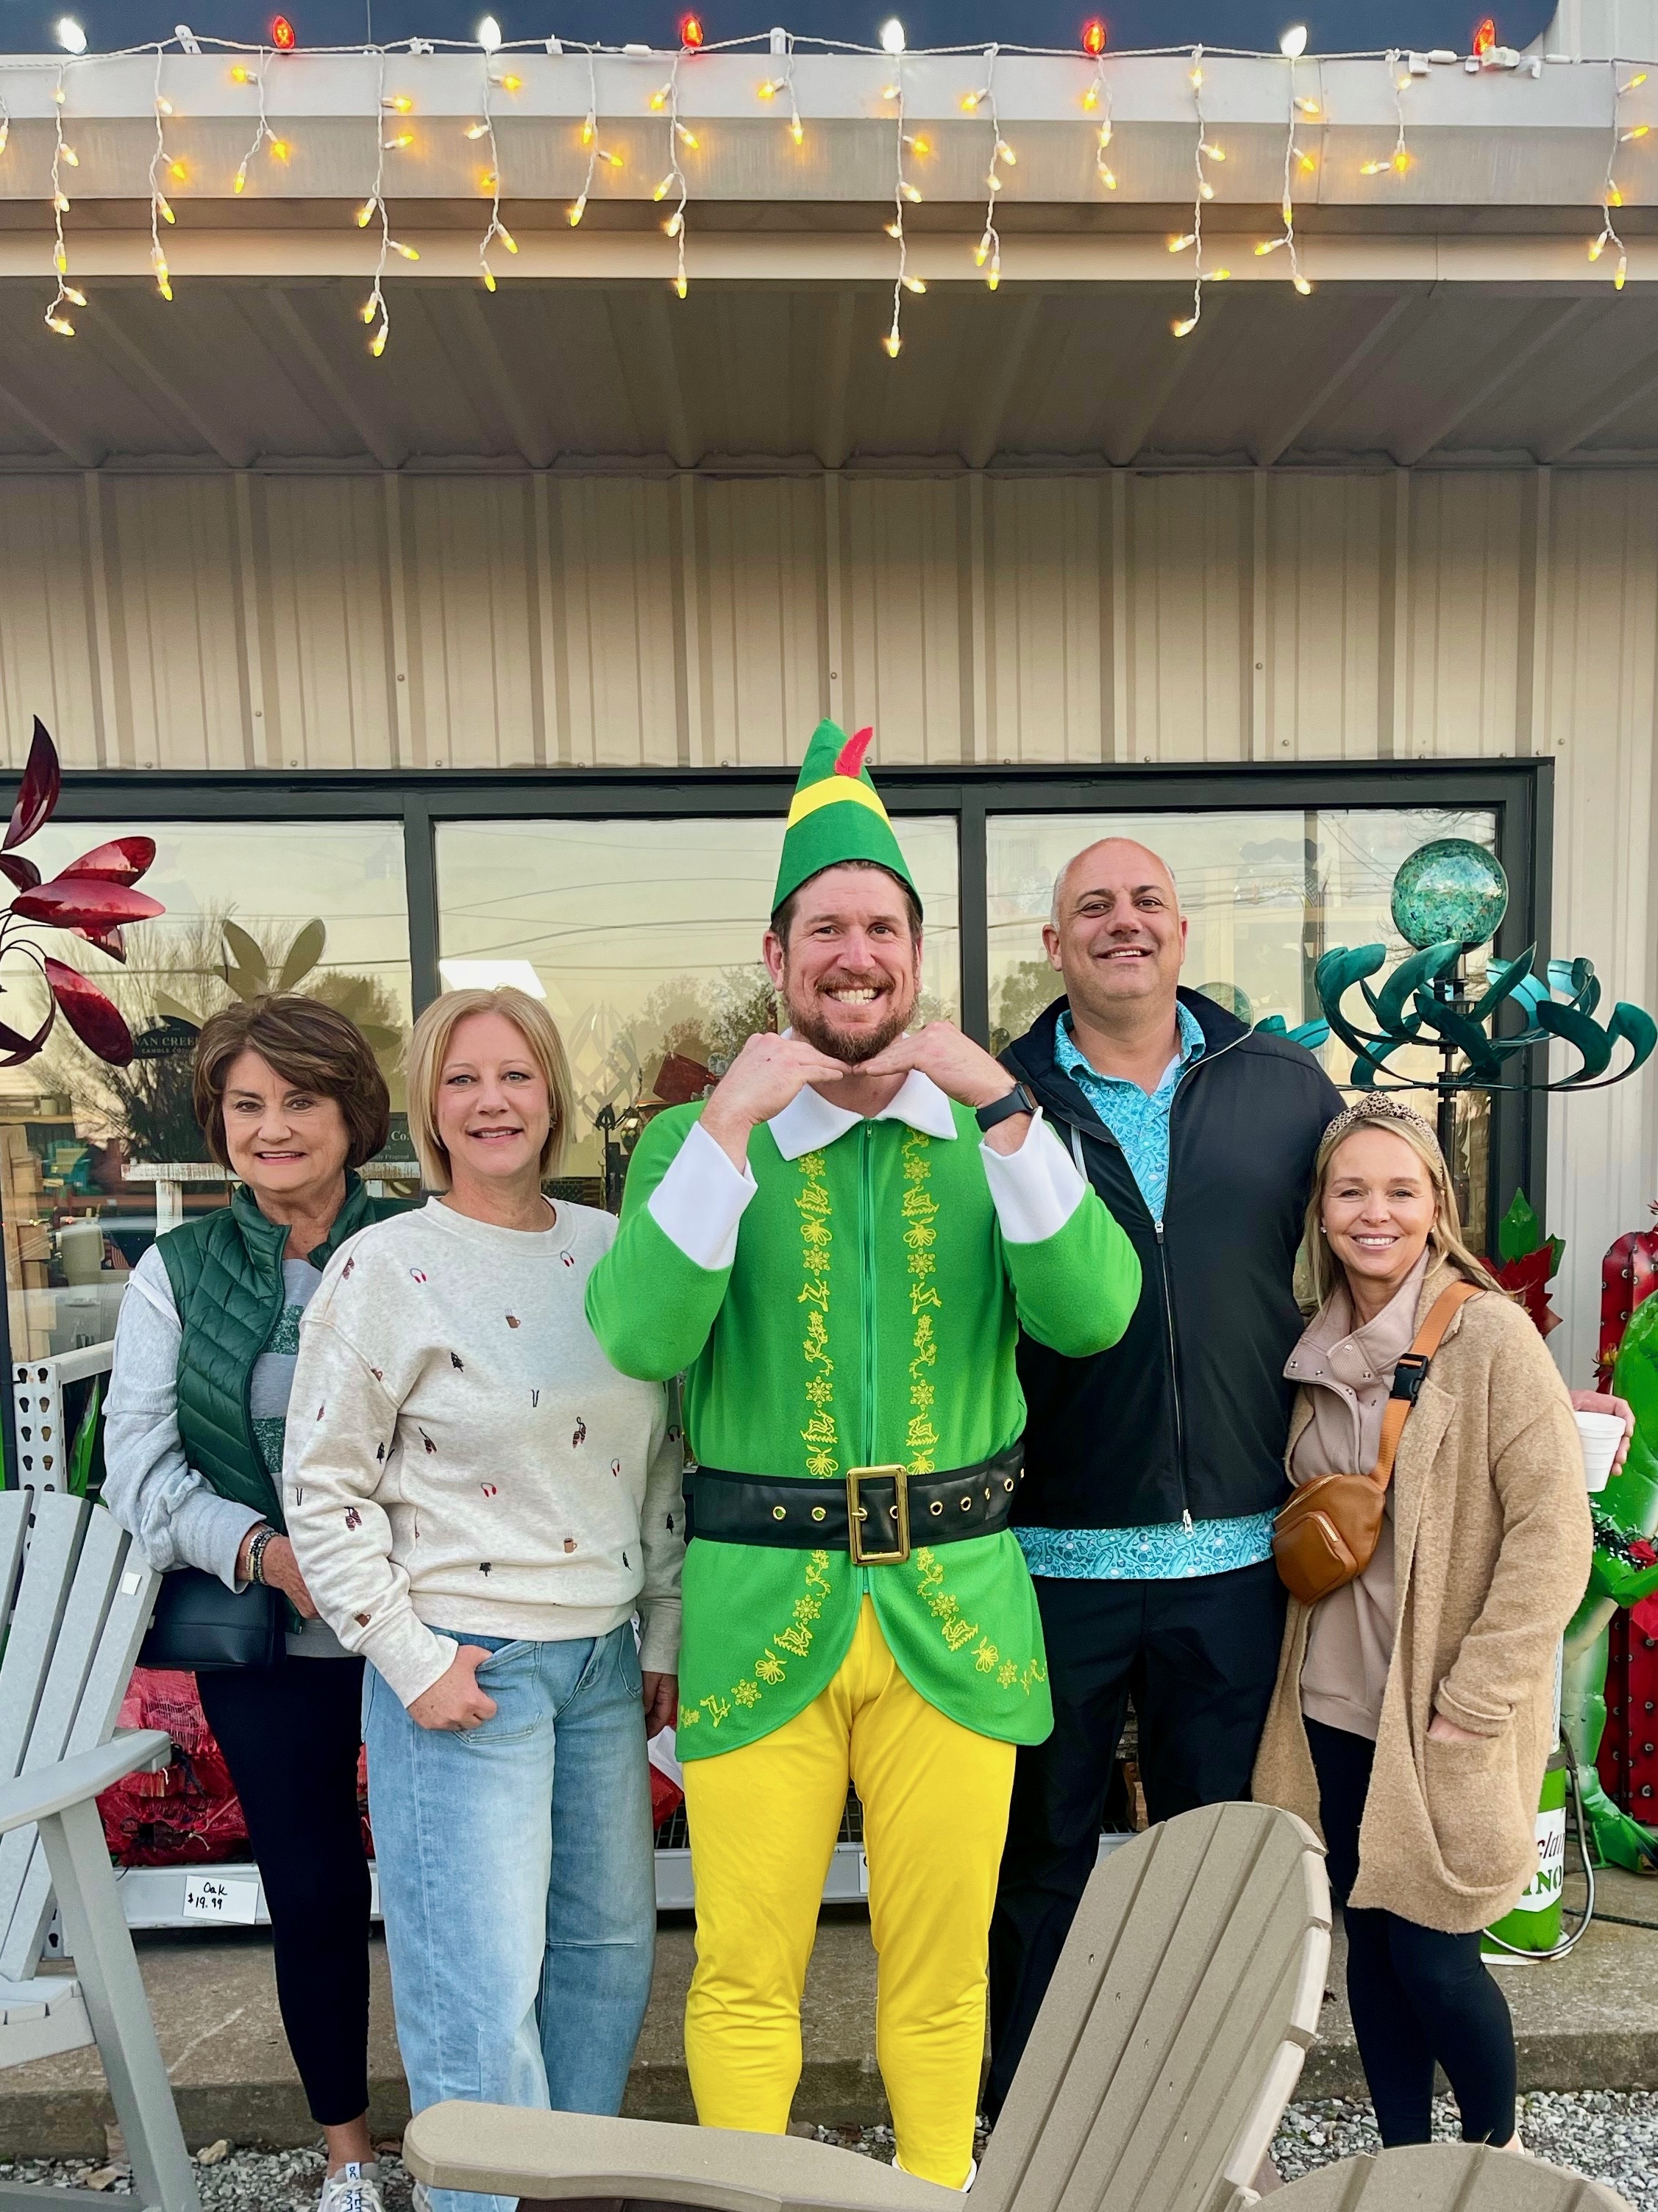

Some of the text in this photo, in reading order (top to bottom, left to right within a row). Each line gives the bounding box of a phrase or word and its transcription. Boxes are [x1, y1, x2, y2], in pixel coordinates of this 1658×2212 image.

[162, 1036, 198, 1046] CREE
[391, 1130, 410, 1141] Co.
[203, 1882, 228, 1896] Oak
[188, 1892, 223, 1910] $19.99
